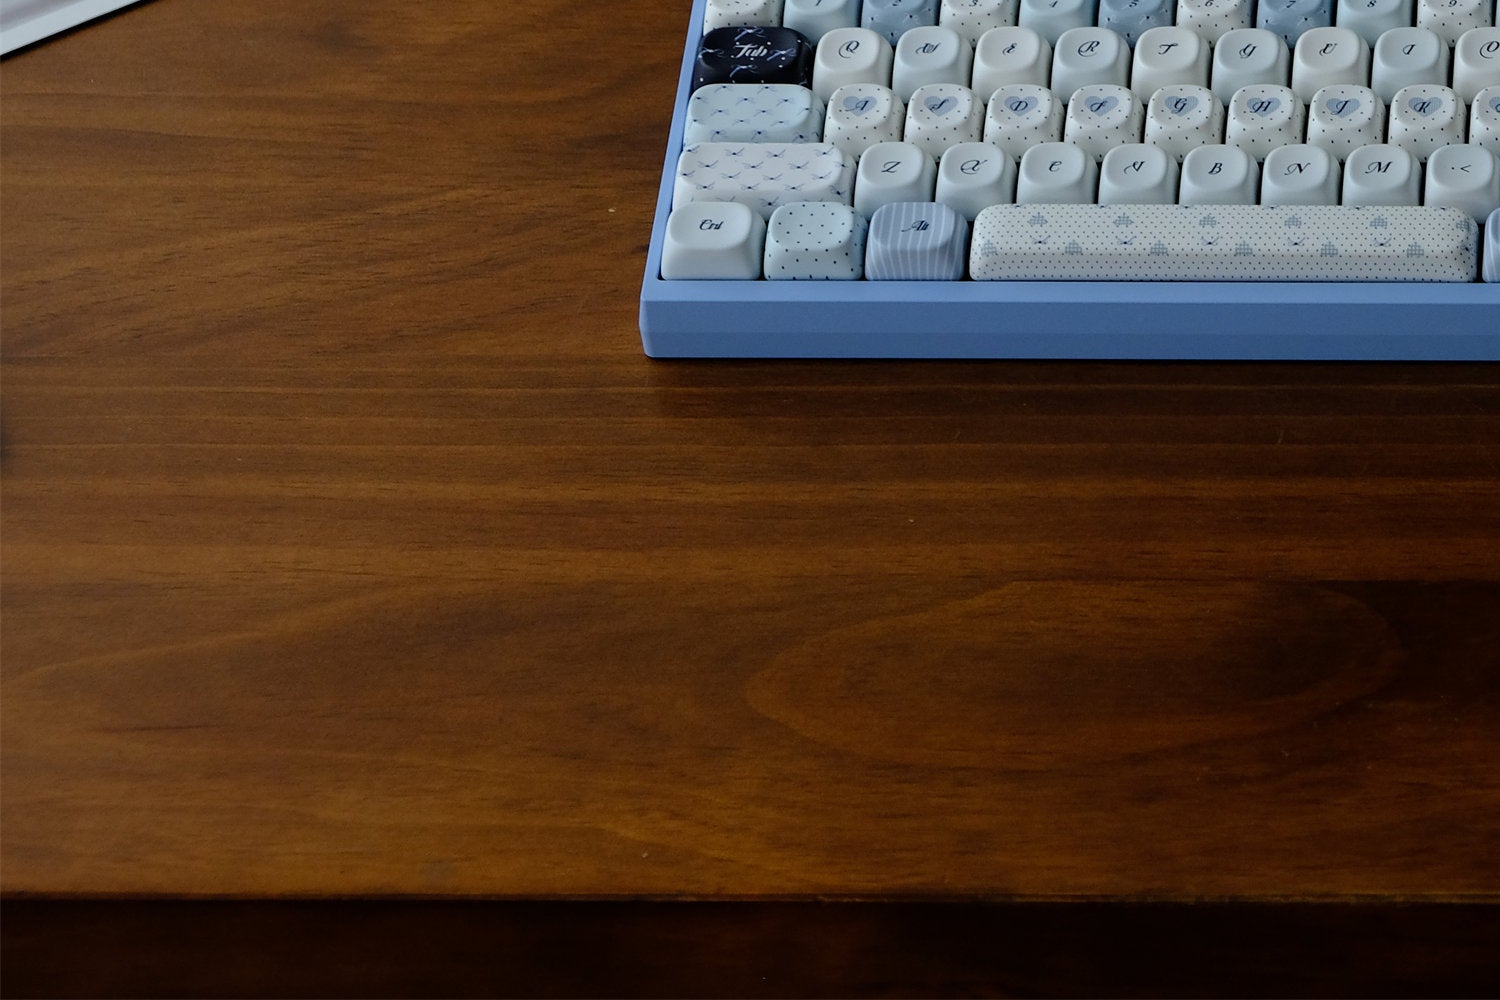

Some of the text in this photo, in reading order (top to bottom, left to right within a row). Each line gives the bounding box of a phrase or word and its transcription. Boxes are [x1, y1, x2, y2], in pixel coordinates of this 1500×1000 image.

[1204, 0, 1213, 7] 6
[1285, 0, 1296, 8] 7
[1367, 0, 1377, 8] 8
[1448, 0, 1457, 8] 9
[732, 43, 767, 59] Tab
[838, 40, 857, 59] Q
[1078, 40, 1100, 57] R
[1158, 43, 1178, 55] T
[1479, 41, 1500, 59] O
[1009, 100, 1029, 112] D
[1173, 98, 1187, 113] G
[1250, 101, 1273, 113] H
[1331, 100, 1350, 116] J
[1413, 101, 1433, 114] K
[881, 161, 901, 173] Z
[960, 159, 988, 175] X
[1049, 160, 1063, 172] C
[1123, 160, 1146, 175] V
[1208, 162, 1223, 175] B
[1284, 162, 1311, 176] N
[1365, 161, 1393, 174] M
